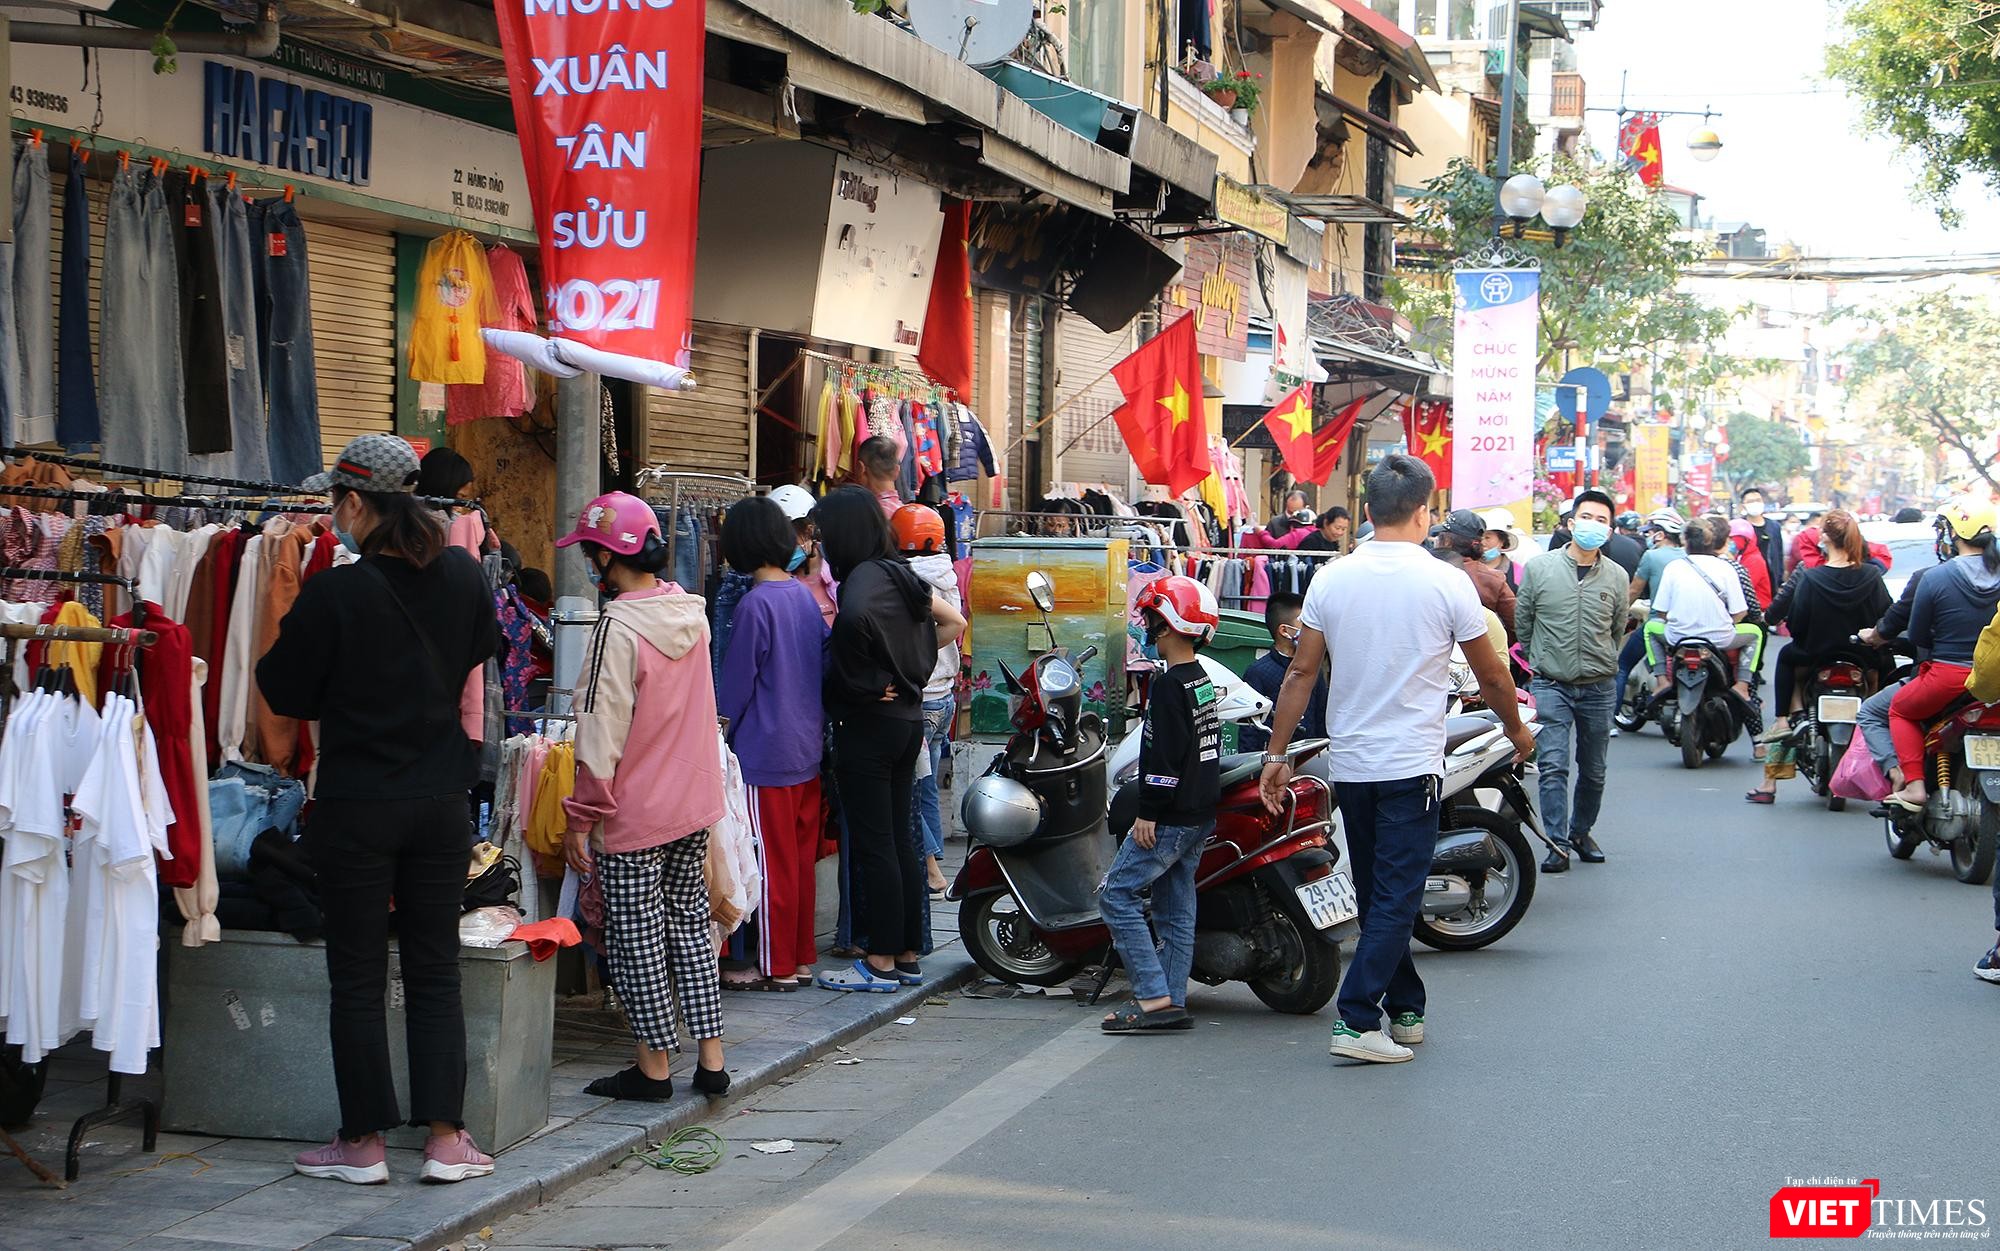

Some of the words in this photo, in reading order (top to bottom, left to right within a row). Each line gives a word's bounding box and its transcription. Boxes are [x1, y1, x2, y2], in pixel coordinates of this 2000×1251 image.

[531, 42, 667, 96] XUÂN
[203, 61, 373, 187] HAFASCO
[555, 122, 646, 170] TÂN
[453, 168, 463, 183] 22
[553, 197, 647, 249] SỬU
[1473, 340, 1518, 355] CHÚC
[1471, 364, 1519, 379] MỪNG
[1476, 388, 1512, 403] NĂM
[1478, 412, 1509, 427] MỚI
[1470, 436, 1515, 451] 2021
[1304, 876, 1347, 906] 29-C1
